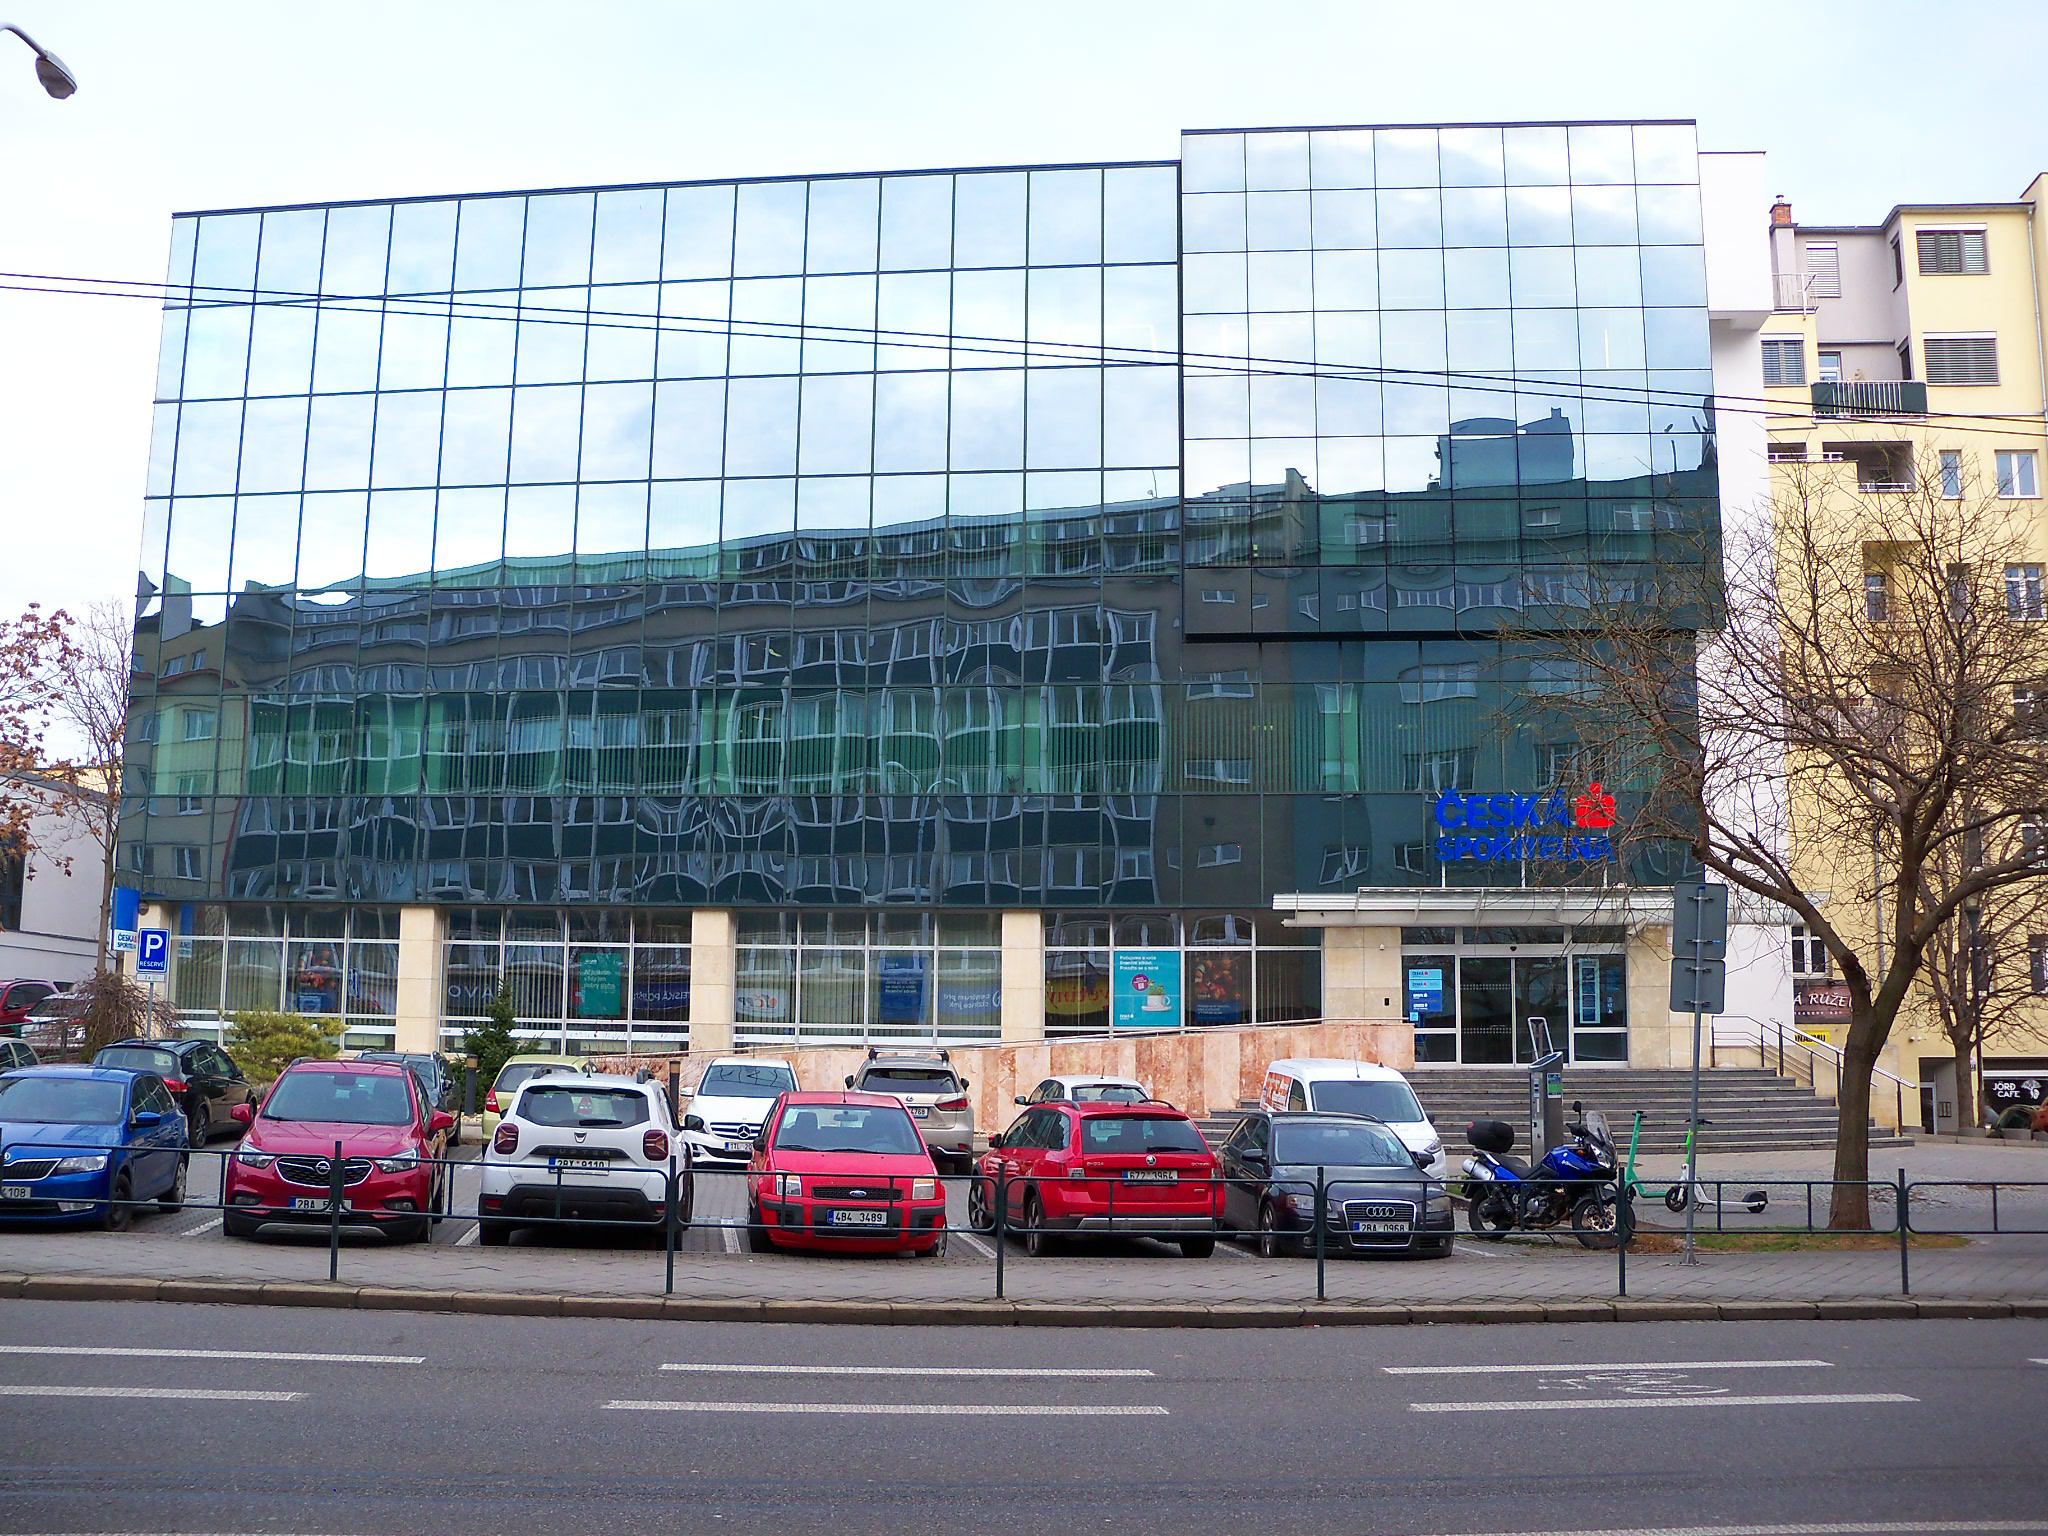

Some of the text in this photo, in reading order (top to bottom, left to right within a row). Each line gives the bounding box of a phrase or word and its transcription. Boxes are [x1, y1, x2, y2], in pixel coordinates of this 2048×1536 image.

[1435, 788, 1573, 829] ČESKÁ
[1435, 830, 1618, 862] SPOŘITELNA
[145, 934, 163, 958] P
[3, 1188, 26, 1197] 108
[860, 1213, 882, 1222] 3489
